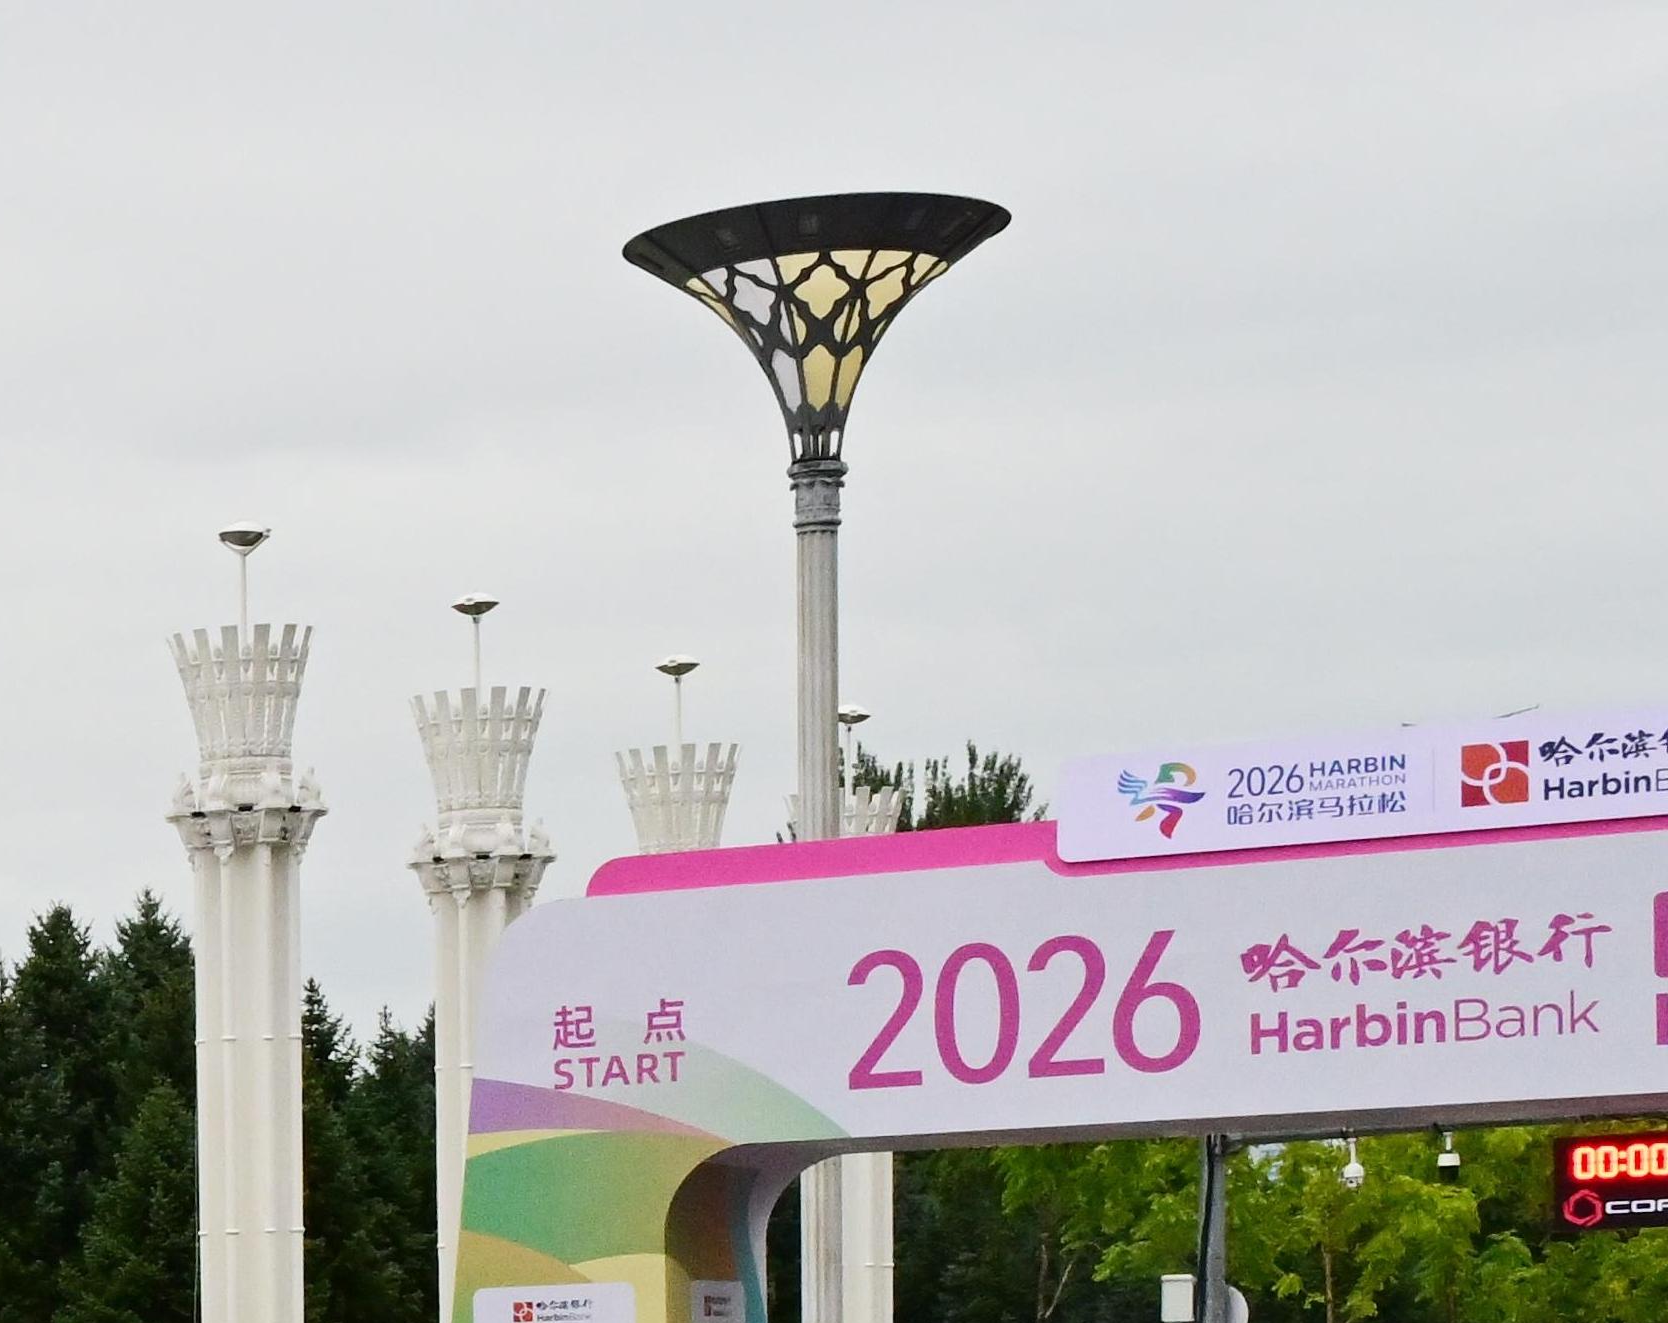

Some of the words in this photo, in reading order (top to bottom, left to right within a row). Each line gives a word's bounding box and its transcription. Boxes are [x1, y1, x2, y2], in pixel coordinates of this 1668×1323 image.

[1227, 763, 1304, 799] 2026
[1309, 754, 1406, 777] HARBIN
[1309, 773, 1406, 792] MARATHON
[1227, 791, 1406, 826] 哈尔滨马拉松
[1241, 912, 1613, 994] 哈尔滨银行
[848, 930, 1201, 1091] 2026
[1250, 989, 1601, 1057] HarbinBank
[553, 1048, 684, 1092] START
